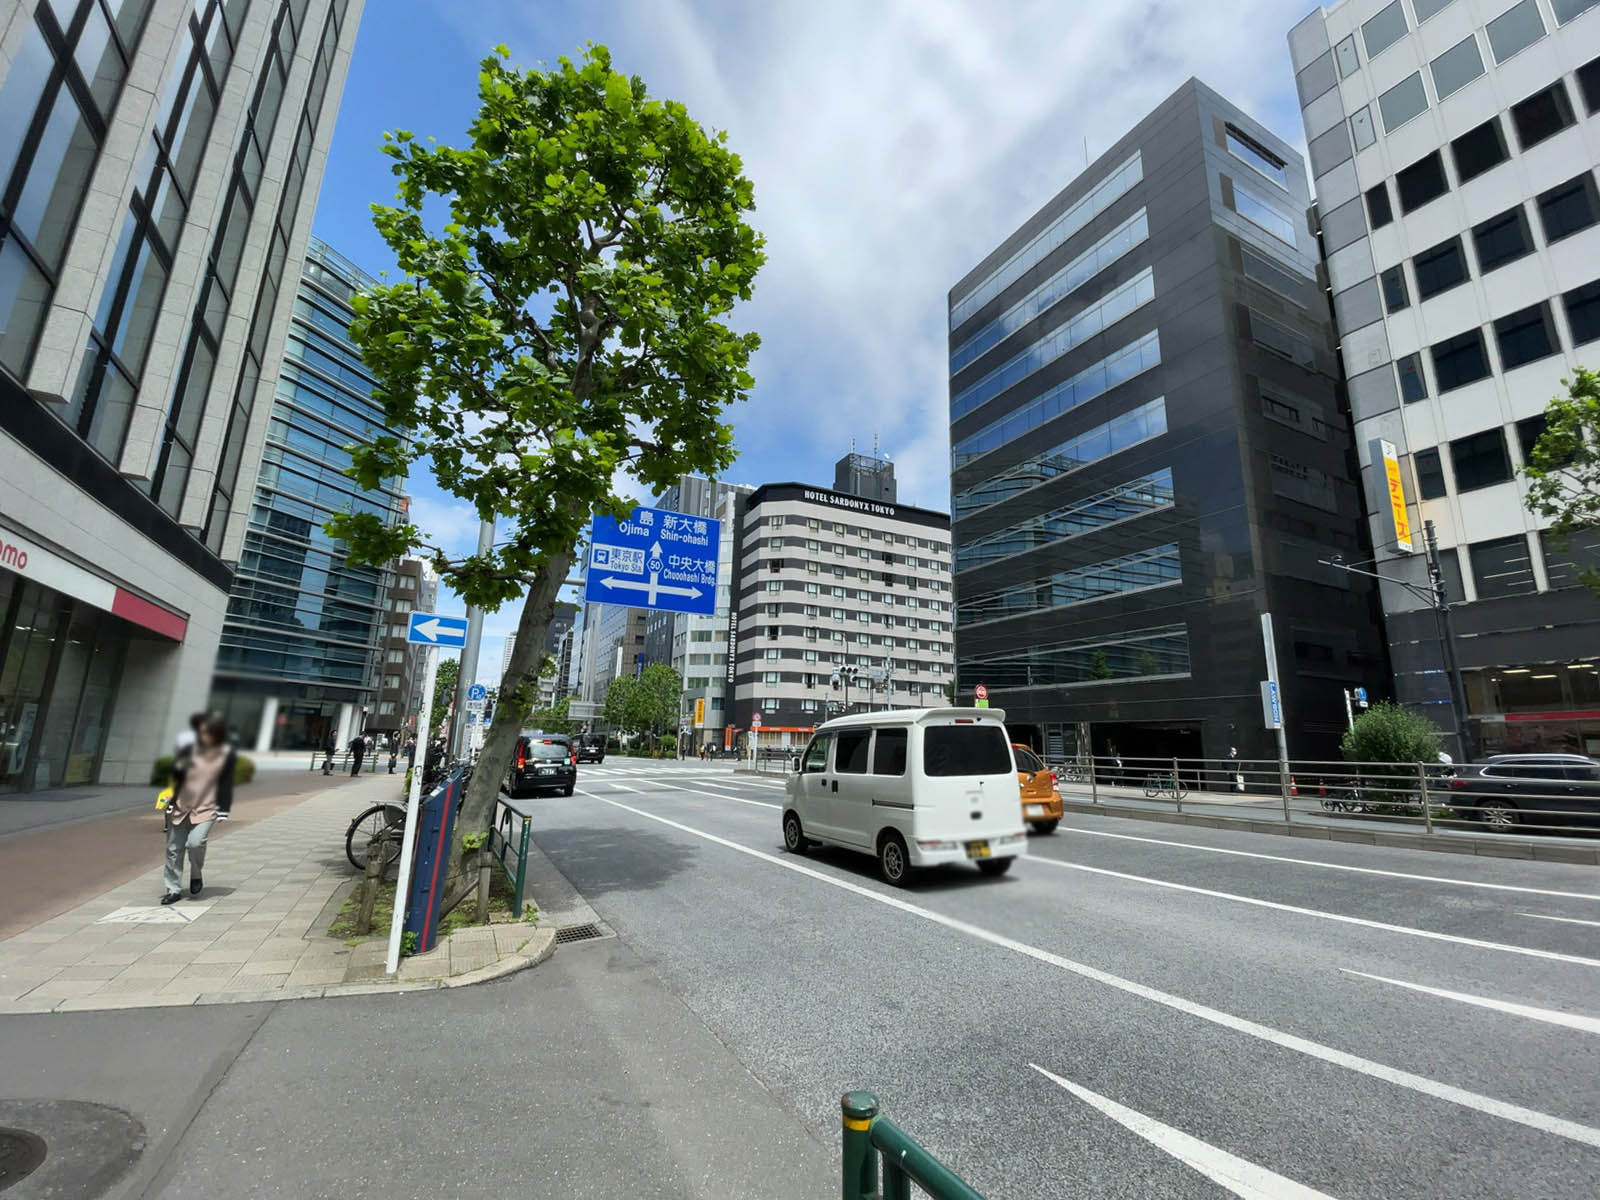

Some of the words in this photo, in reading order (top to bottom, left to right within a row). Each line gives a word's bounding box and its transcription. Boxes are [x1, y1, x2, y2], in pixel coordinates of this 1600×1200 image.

[804, 490, 828, 503] HOTEL
[829, 496, 869, 511] SARDONYX
[870, 504, 895, 516] TOKYO
[1389, 477, 1407, 537] デニーズ
[619, 520, 650, 537] Ojima
[663, 514, 708, 535] 新大橋
[660, 529, 709, 546] Shin-ohashi
[610, 548, 643, 564] 東京駅
[610, 560, 630, 572] Tokyo
[650, 561, 661, 570] 50
[668, 554, 716, 575] 中央大橋
[730, 611, 738, 629] HOTEL
[729, 630, 737, 662] SARDONYX
[727, 663, 735, 683] TOKYO
[1269, 681, 1281, 722] LAWSON
